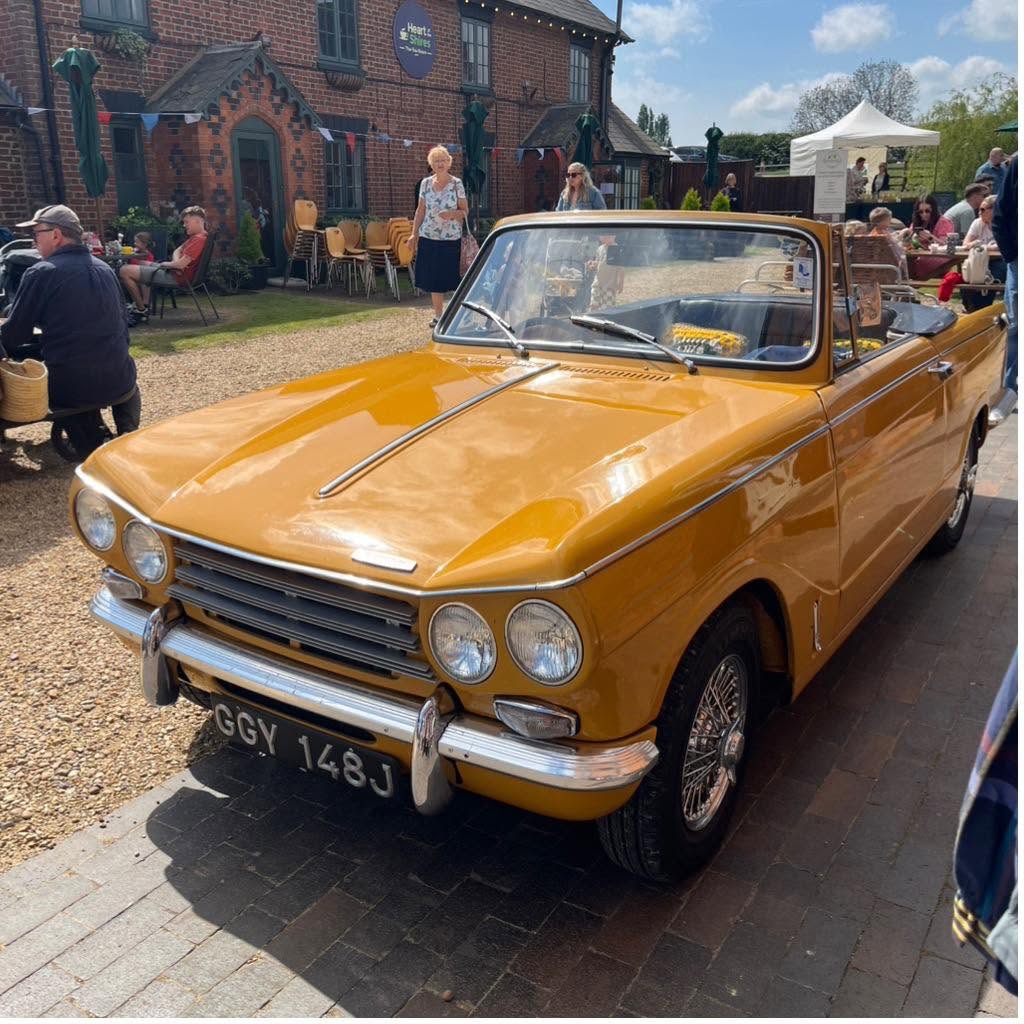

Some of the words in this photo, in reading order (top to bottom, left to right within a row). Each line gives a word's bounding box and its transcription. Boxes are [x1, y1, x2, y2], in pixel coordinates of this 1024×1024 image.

[407, 22, 427, 36] Heart
[409, 35, 431, 48] Shires
[215, 703, 277, 755] GGY
[299, 735, 394, 798] 148J
